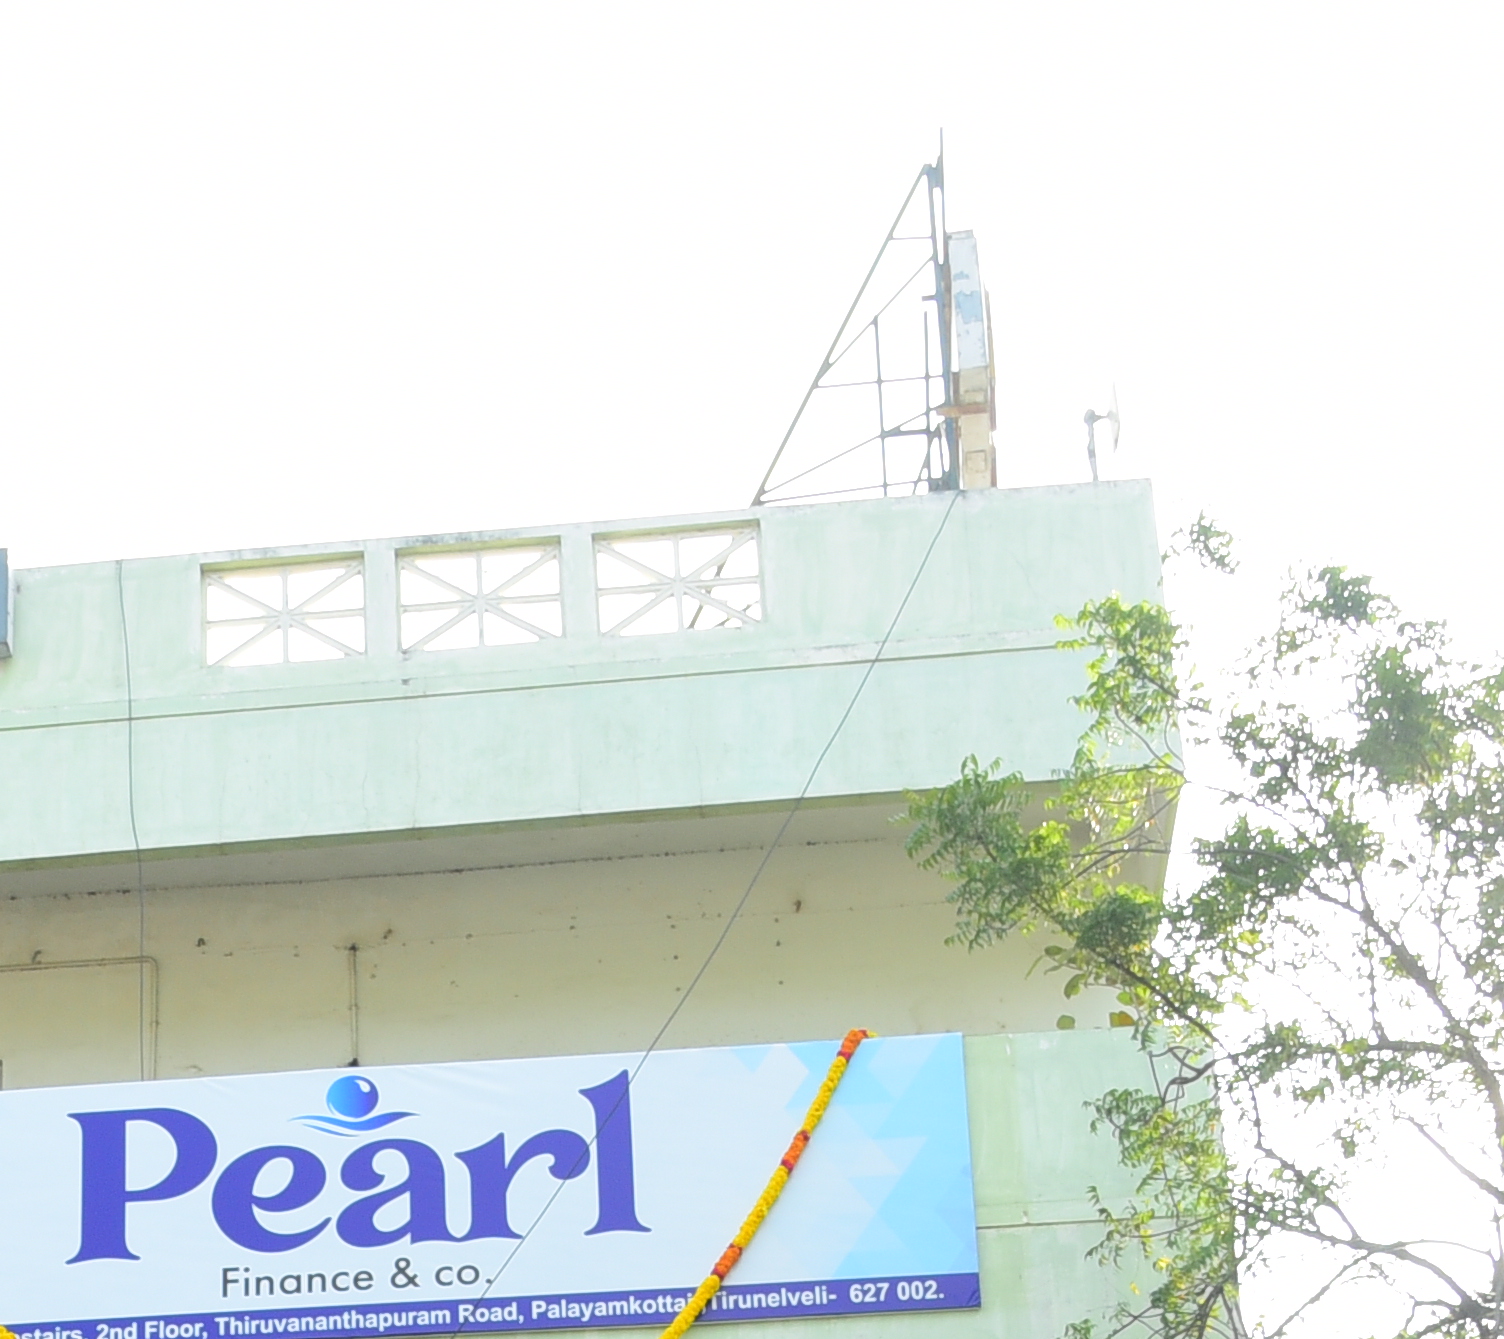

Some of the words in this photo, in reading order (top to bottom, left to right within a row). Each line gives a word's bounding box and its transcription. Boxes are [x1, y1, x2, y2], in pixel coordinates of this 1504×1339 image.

[64, 1067, 652, 1265] Pearl
[221, 1267, 374, 1298] Finance
[390, 1257, 421, 1289] &
[435, 1263, 493, 1287] co.
[215, 1308, 452, 1336] Thiruvananthapuram
[458, 1302, 524, 1325] Road,
[849, 1283, 888, 1304] 627
[897, 1279, 945, 1301] 002.
